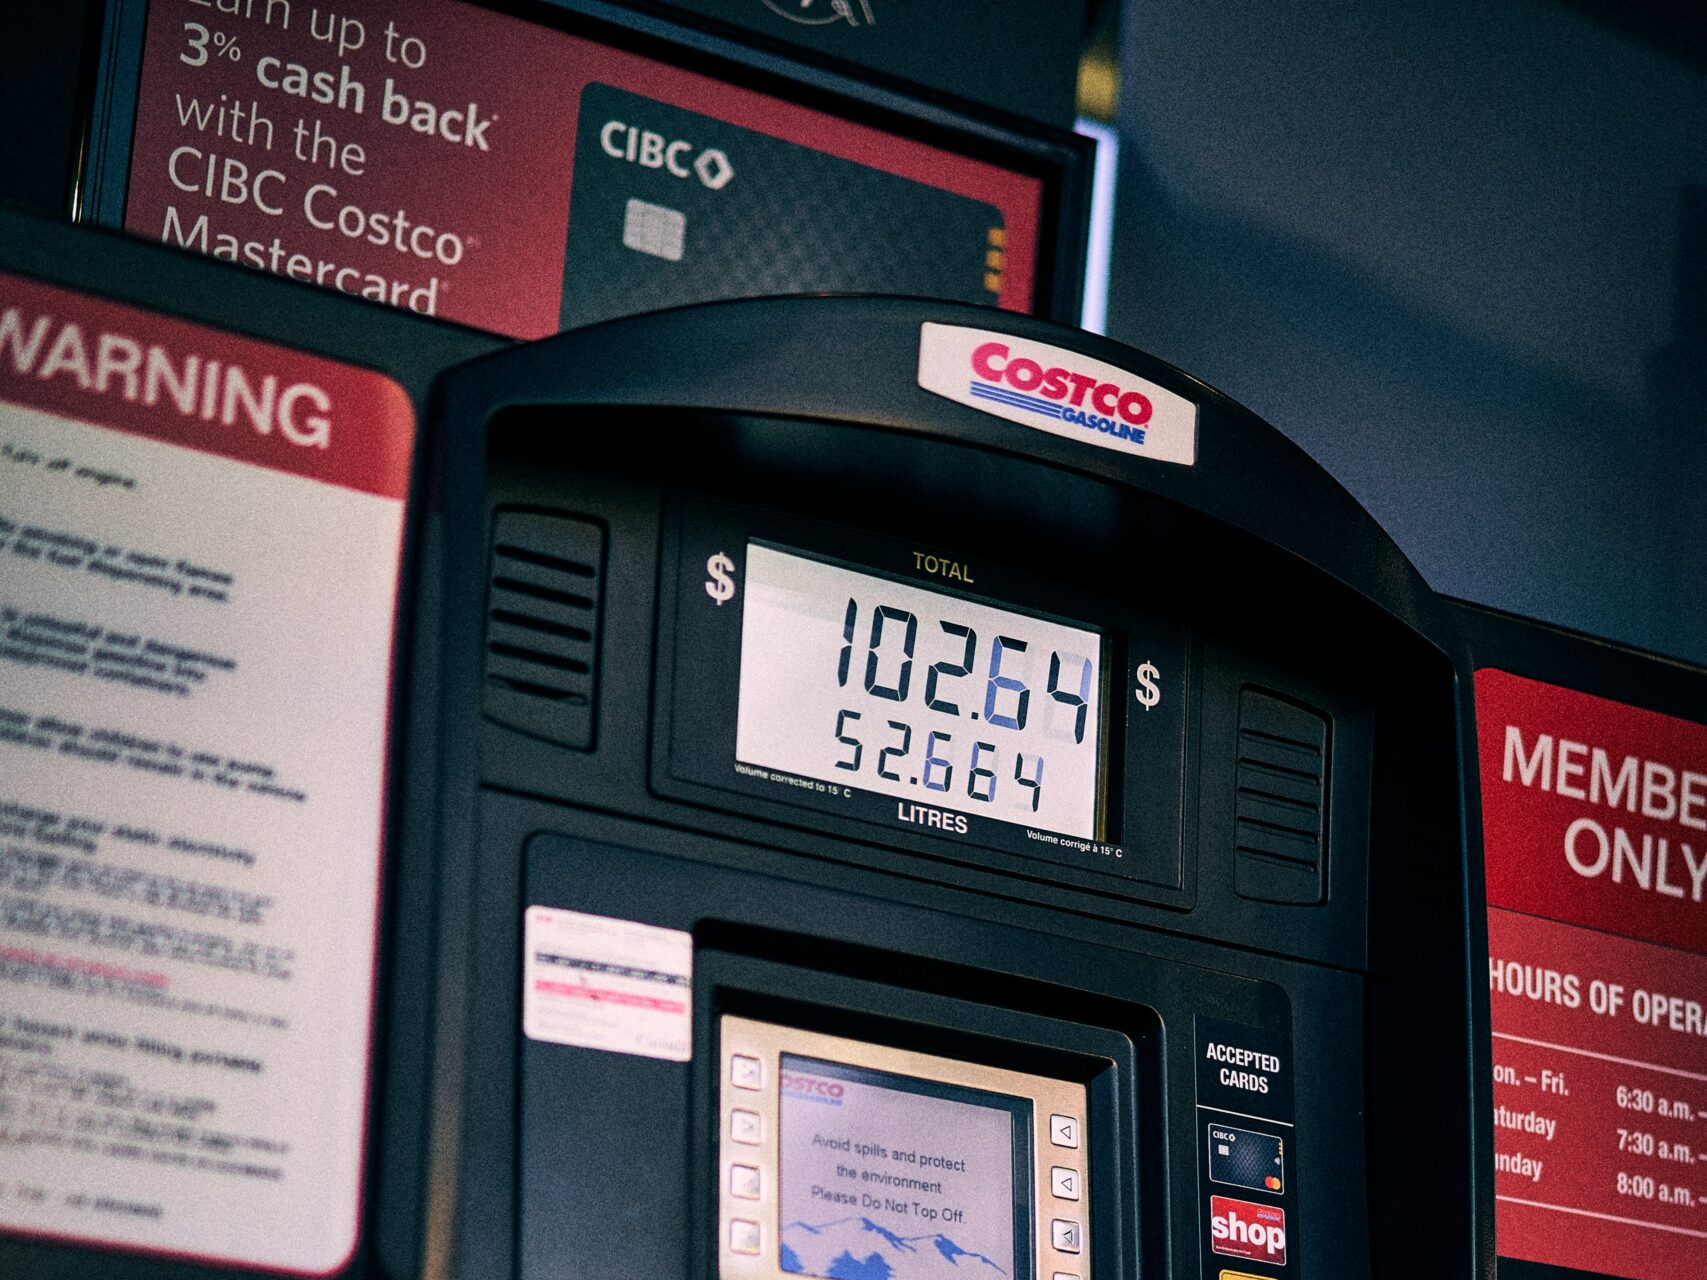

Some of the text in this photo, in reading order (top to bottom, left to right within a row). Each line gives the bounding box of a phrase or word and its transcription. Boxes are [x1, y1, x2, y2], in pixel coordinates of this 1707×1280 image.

[310, 8, 366, 57] up
[383, 20, 428, 69] to
[256, 54, 366, 115] cash
[175, 93, 367, 177] with the
[600, 120, 692, 178] CIBC
[167, 145, 465, 266] CIBC Costco
[160, 205, 440, 317] Mastercard
[0, 307, 331, 451] WARNING
[970, 342, 1153, 426] COSTCO
[1060, 407, 1146, 446] GASOLINE
[704, 551, 736, 605] $
[913, 551, 975, 583] TOTAL
[836, 597, 1093, 745] 102.64
[1135, 660, 1161, 711] $
[734, 763, 768, 780] Volume
[770, 772, 814, 790] corrected
[815, 783, 825, 793] to
[843, 788, 852, 798] C
[834, 708, 1045, 813] 52.664
[1502, 724, 1707, 832] MEMBE
[897, 802, 968, 835] LITRES
[1026, 829, 1059, 844] Volume
[1060, 837, 1091, 853] corrigé
[1092, 843, 1098, 853] à
[1115, 848, 1123, 858] C
[1563, 816, 1707, 902] ONLY
[1488, 956, 1582, 1009] HOURS
[1589, 979, 1625, 1017] OF
[1206, 1042, 1281, 1074] ACCEPTED
[1219, 1067, 1269, 1095] CARDS
[1541, 1069, 1569, 1096] Fri.
[1616, 1084, 1654, 1114] 6:30
[1657, 1097, 1695, 1122] a.m.
[811, 1133, 966, 1173] Avoid spills and protect
[1212, 1130, 1229, 1141] CIBC
[1616, 1127, 1654, 1156] 7:30
[1658, 1140, 1695, 1165] a.m.
[836, 1163, 943, 1195] the environment
[1616, 1171, 1654, 1200] 8:00
[1658, 1183, 1695, 1208] a.m.
[810, 1184, 858, 1207] Please
[862, 1193, 882, 1209] Do
[885, 1198, 908, 1214] Not
[911, 1202, 938, 1222] Top
[1211, 1210, 1286, 1255] shop
